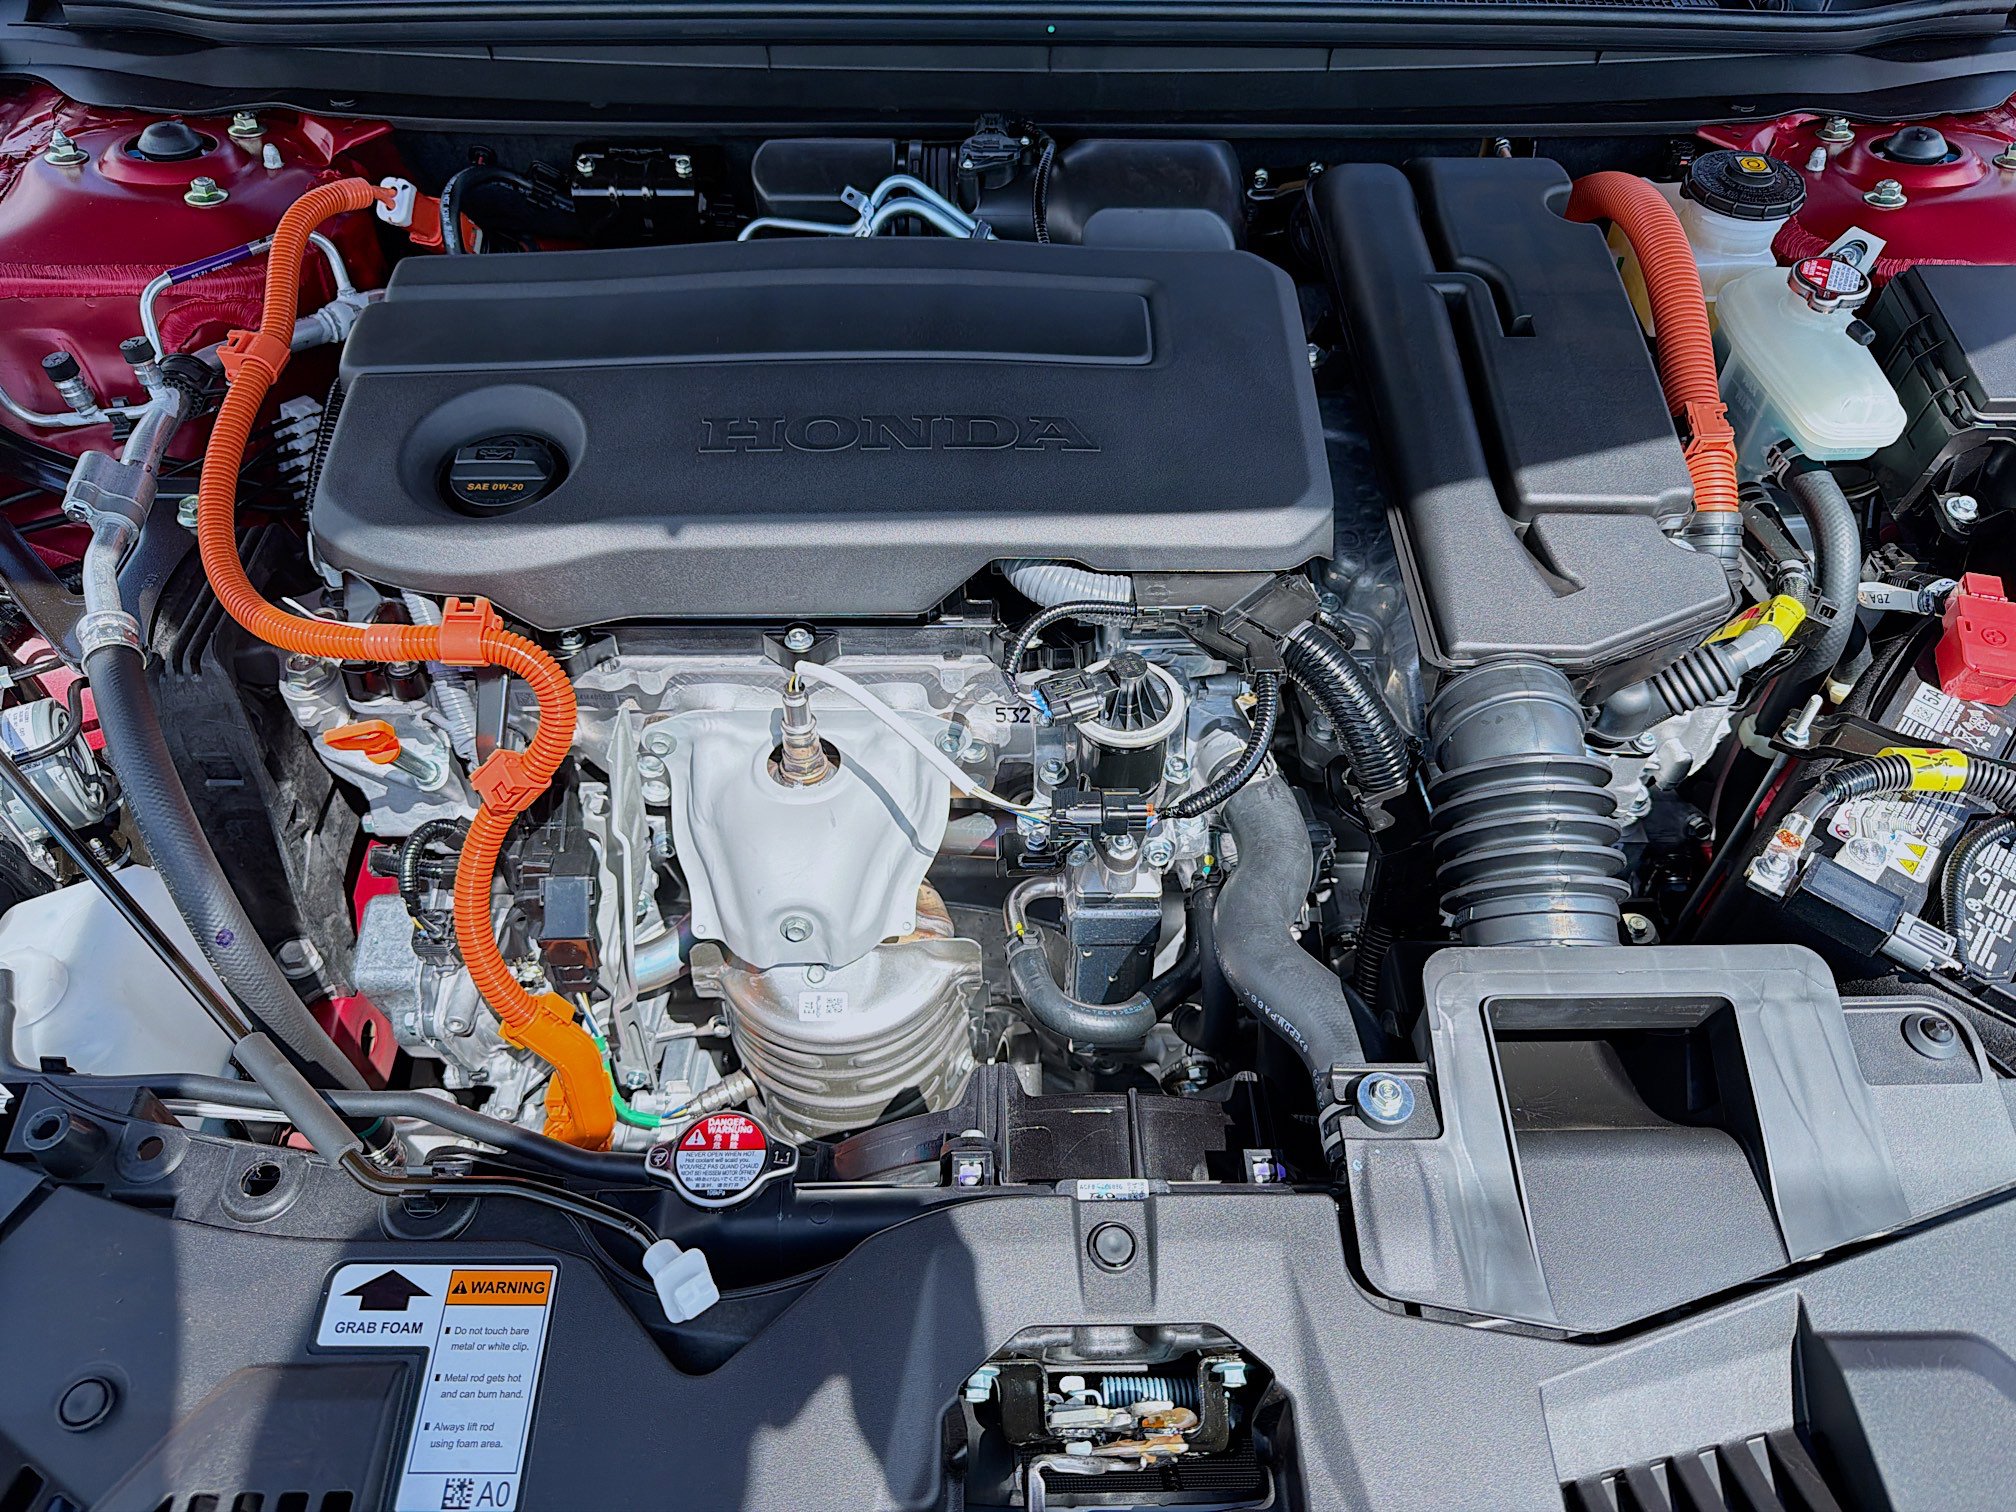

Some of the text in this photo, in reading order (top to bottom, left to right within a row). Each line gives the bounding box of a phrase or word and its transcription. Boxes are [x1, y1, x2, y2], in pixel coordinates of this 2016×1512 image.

[699, 415, 1101, 453] HONDA
[467, 483, 524, 491] SAE 0W-20
[995, 706, 1031, 724] 532
[707, 1118, 746, 1126] DANGER
[774, 1151, 791, 1164] 1.1
[471, 1281, 546, 1294] WARNING
[334, 1322, 424, 1334] GRAB FOAM
[454, 1326, 530, 1335] Do not touch bare
[451, 1341, 475, 1350] metal
[487, 1341, 511, 1350] white
[512, 1341, 529, 1352] clip.
[444, 1374, 522, 1385] Metal rod gets hot
[440, 1390, 459, 1399] and
[477, 1390, 498, 1399] burn
[500, 1389, 523, 1399] hand.
[433, 1422, 495, 1433] Always lift rod
[430, 1440, 454, 1450] using
[456, 1439, 479, 1448] foam
[475, 1481, 511, 1508] A0
